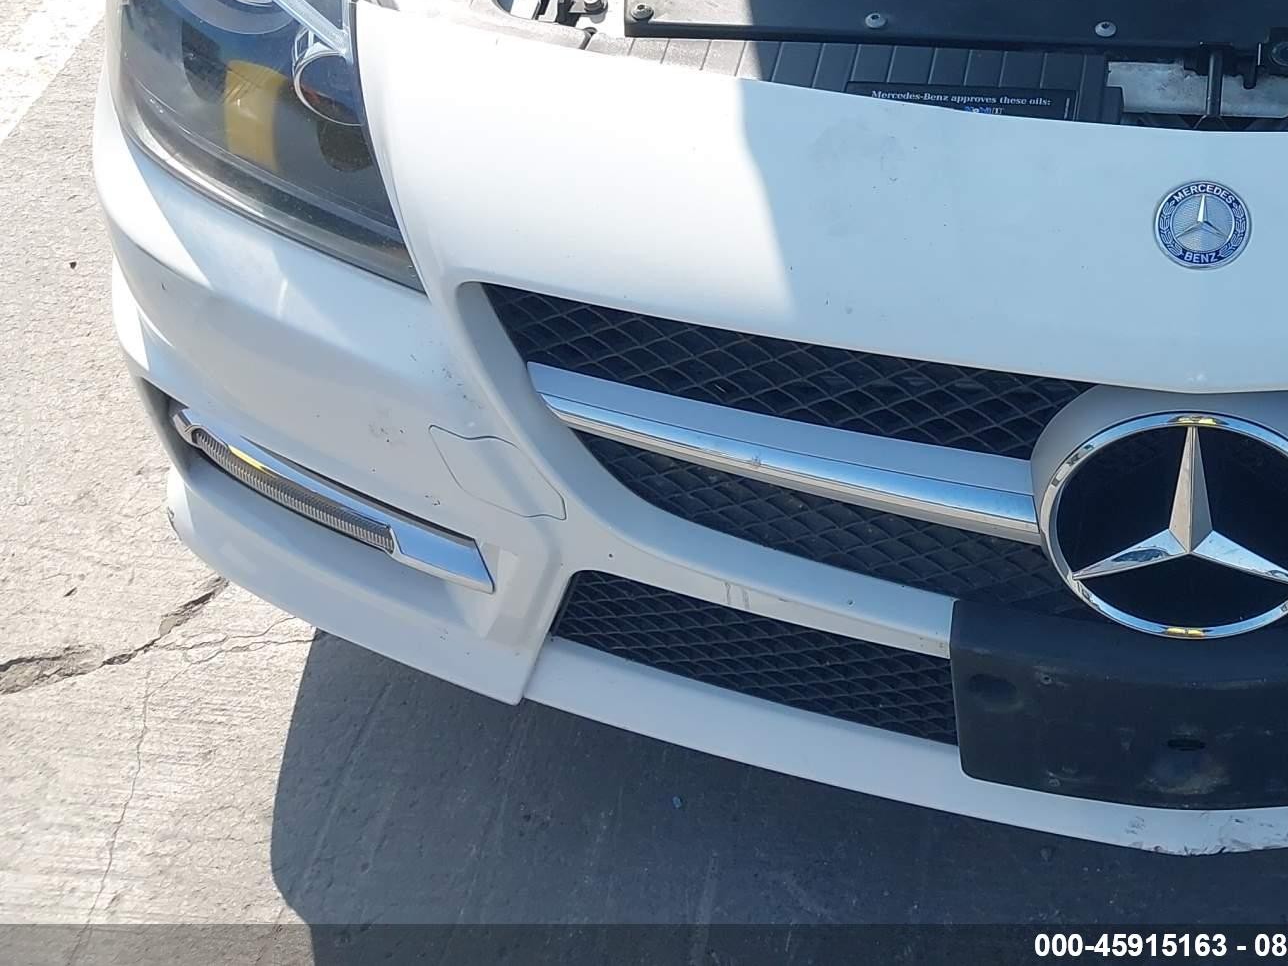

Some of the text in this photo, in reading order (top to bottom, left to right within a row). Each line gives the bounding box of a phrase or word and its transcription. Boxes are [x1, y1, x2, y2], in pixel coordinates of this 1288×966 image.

[871, 90, 1052, 106] Mercedes-Benz approves these oils:
[1173, 184, 1235, 204] MERCEDES
[1184, 251, 1218, 263] BENZ
